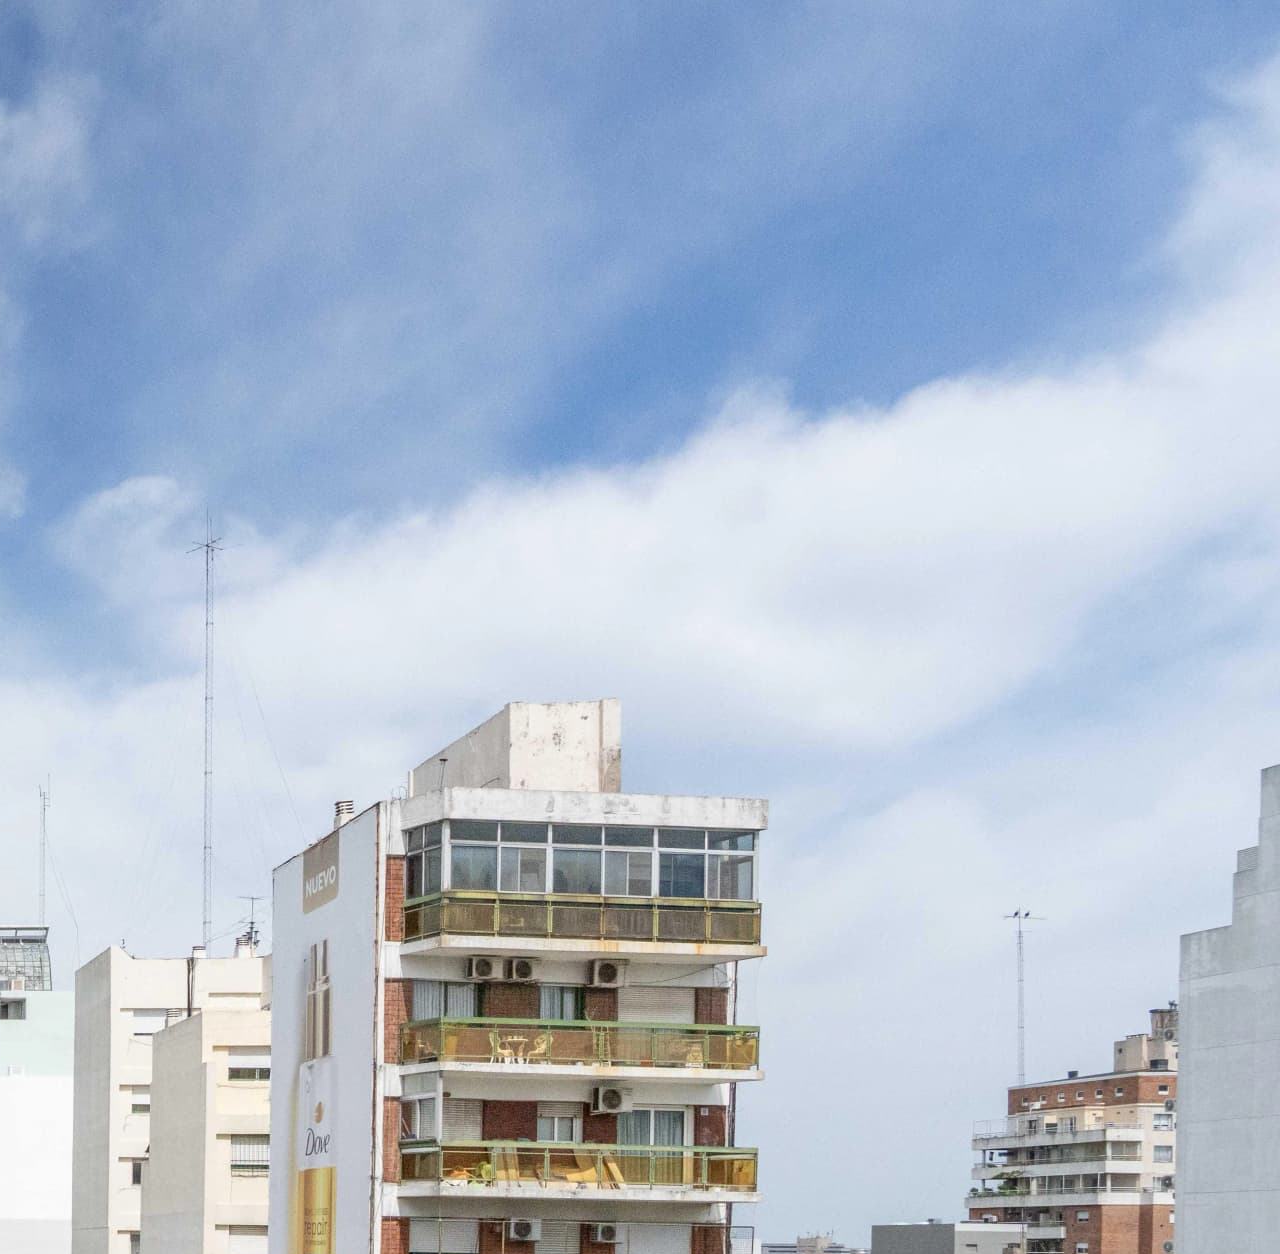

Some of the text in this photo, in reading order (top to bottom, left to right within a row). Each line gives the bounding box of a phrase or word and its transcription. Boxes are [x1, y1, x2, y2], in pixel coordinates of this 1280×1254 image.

[305, 865, 336, 898] NUEVO
[305, 1127, 331, 1156] Dove
[304, 1217, 328, 1237] repair
